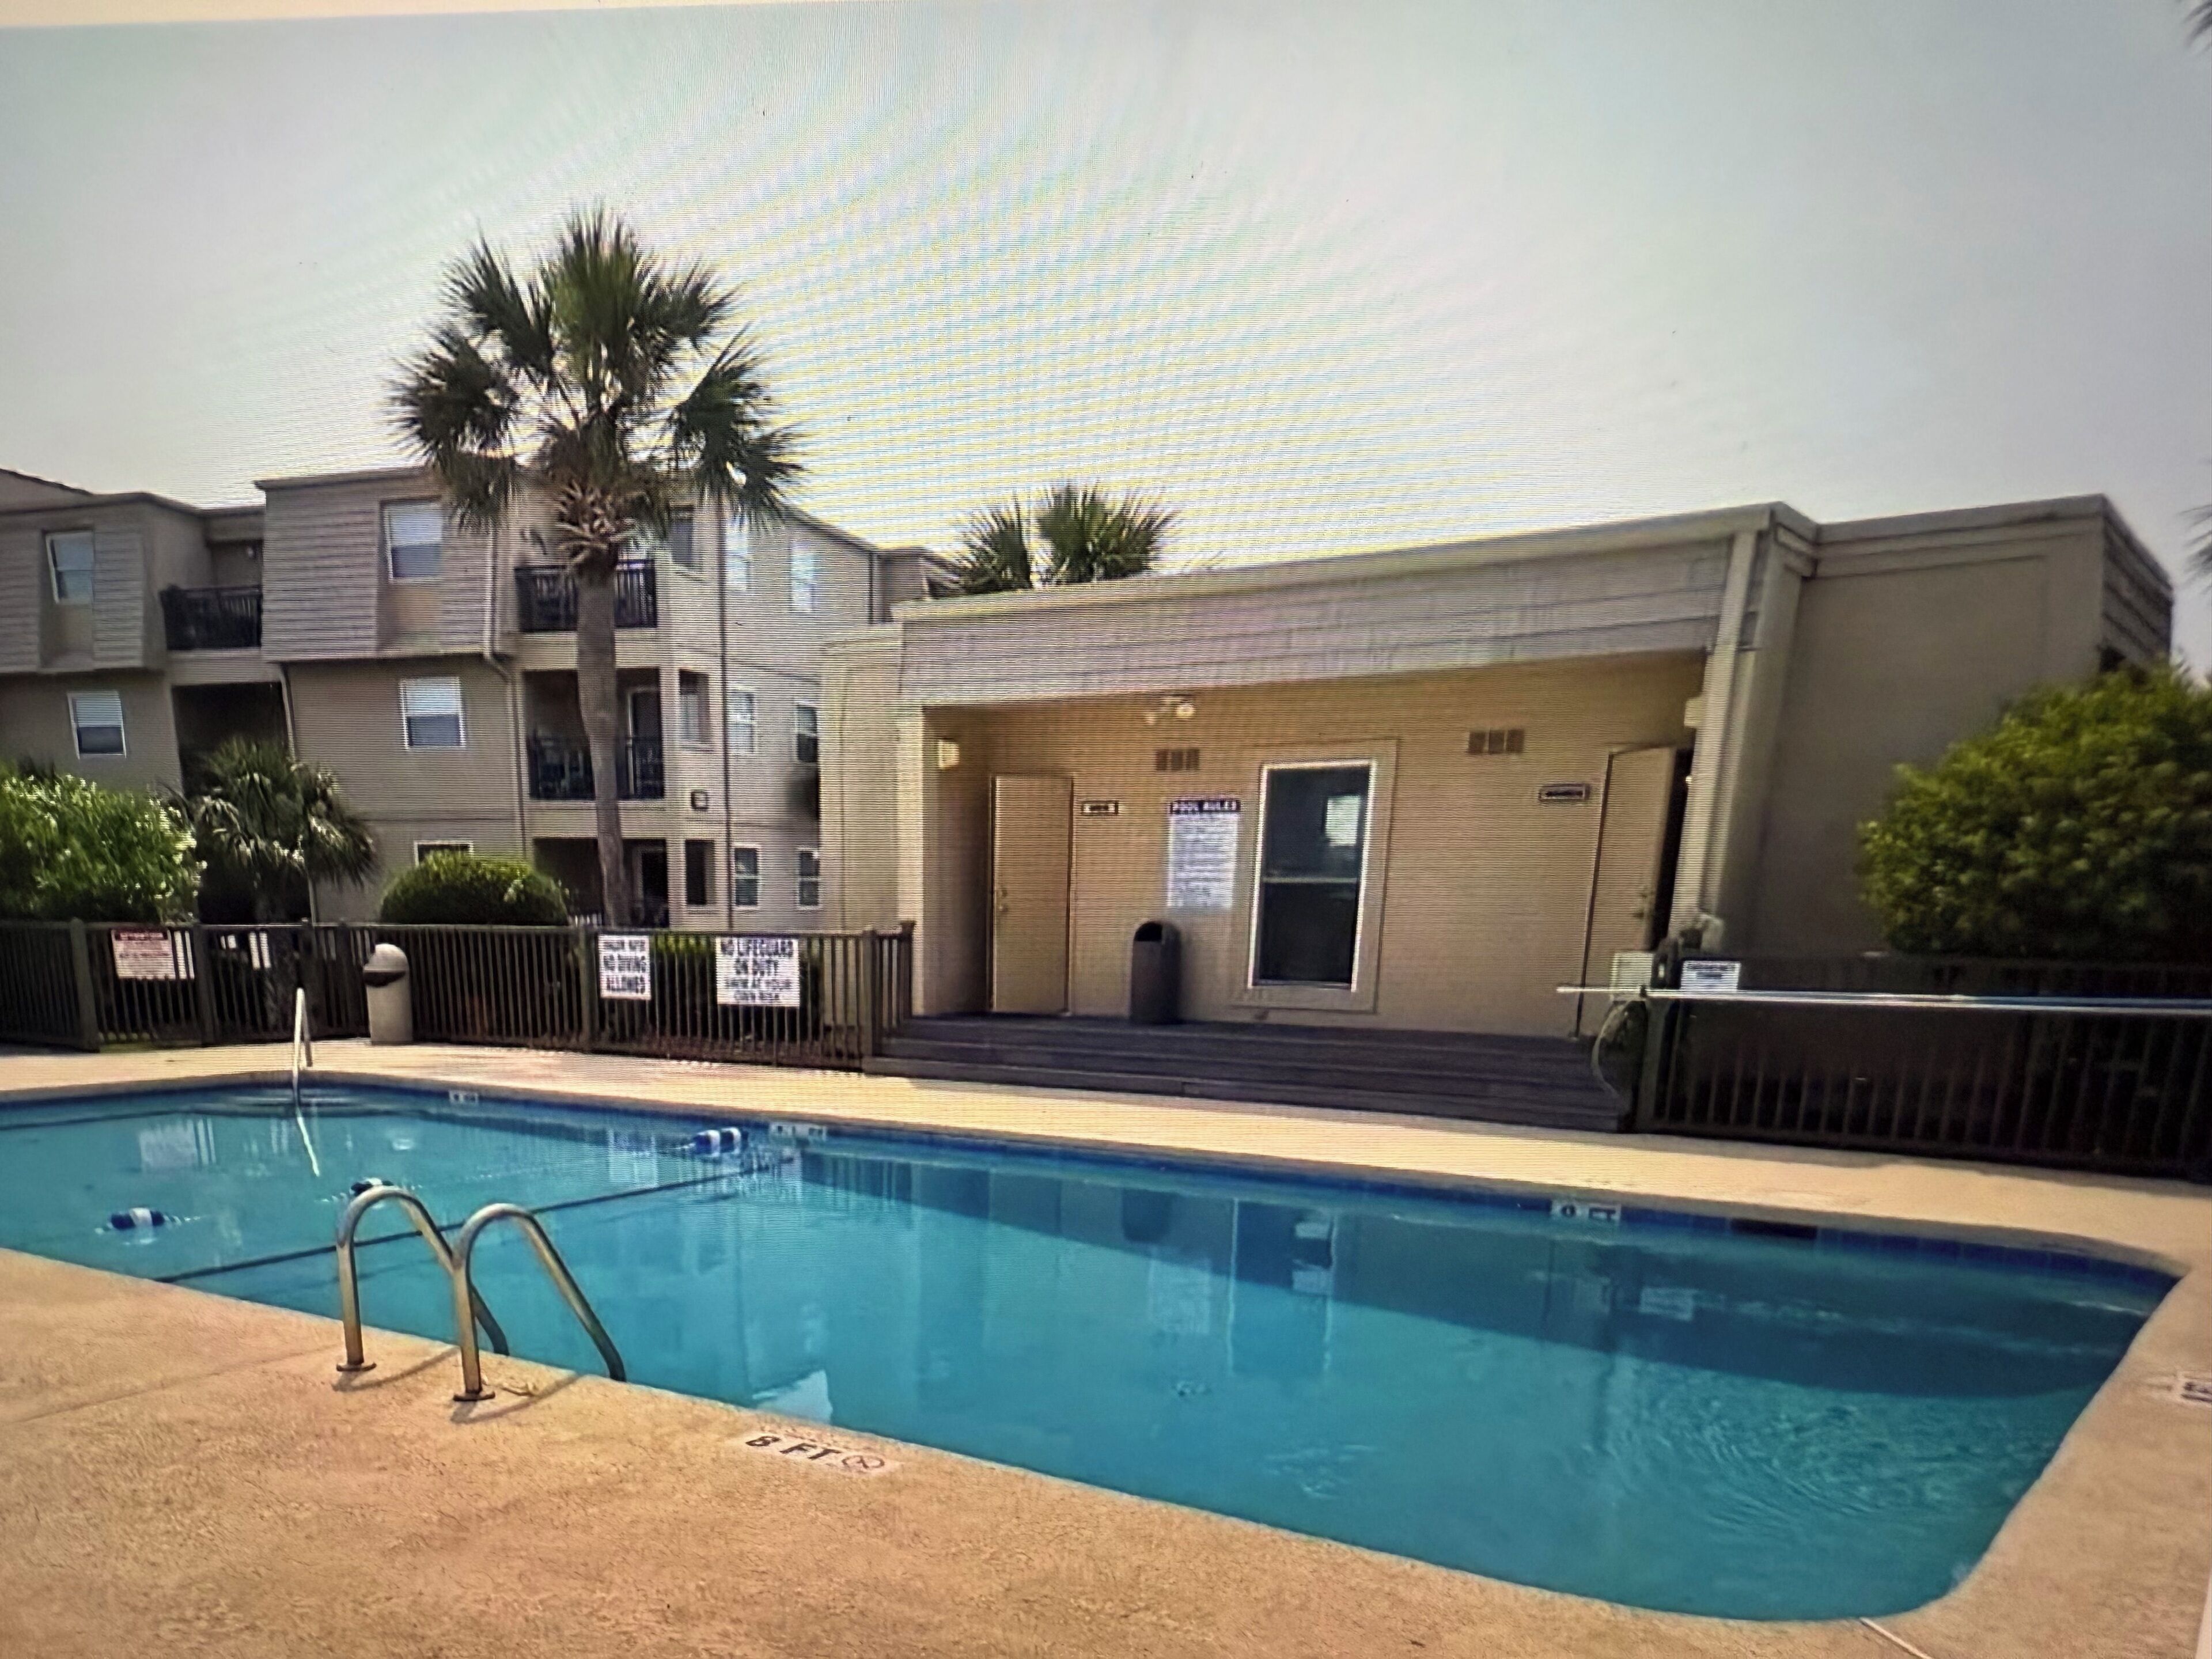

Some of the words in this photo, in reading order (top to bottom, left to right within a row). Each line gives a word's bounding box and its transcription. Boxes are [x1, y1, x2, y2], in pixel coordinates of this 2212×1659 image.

[721, 939, 733, 956] NO
[737, 939, 793, 958] LIFEGUARD
[603, 955, 615, 971] NO
[618, 954, 646, 973] DIVING
[735, 958, 748, 975] ON
[753, 959, 778, 976] DUTY
[606, 975, 646, 994] ALLOWED
[745, 1435, 782, 1447] 8
[779, 1442, 842, 1461] FT
